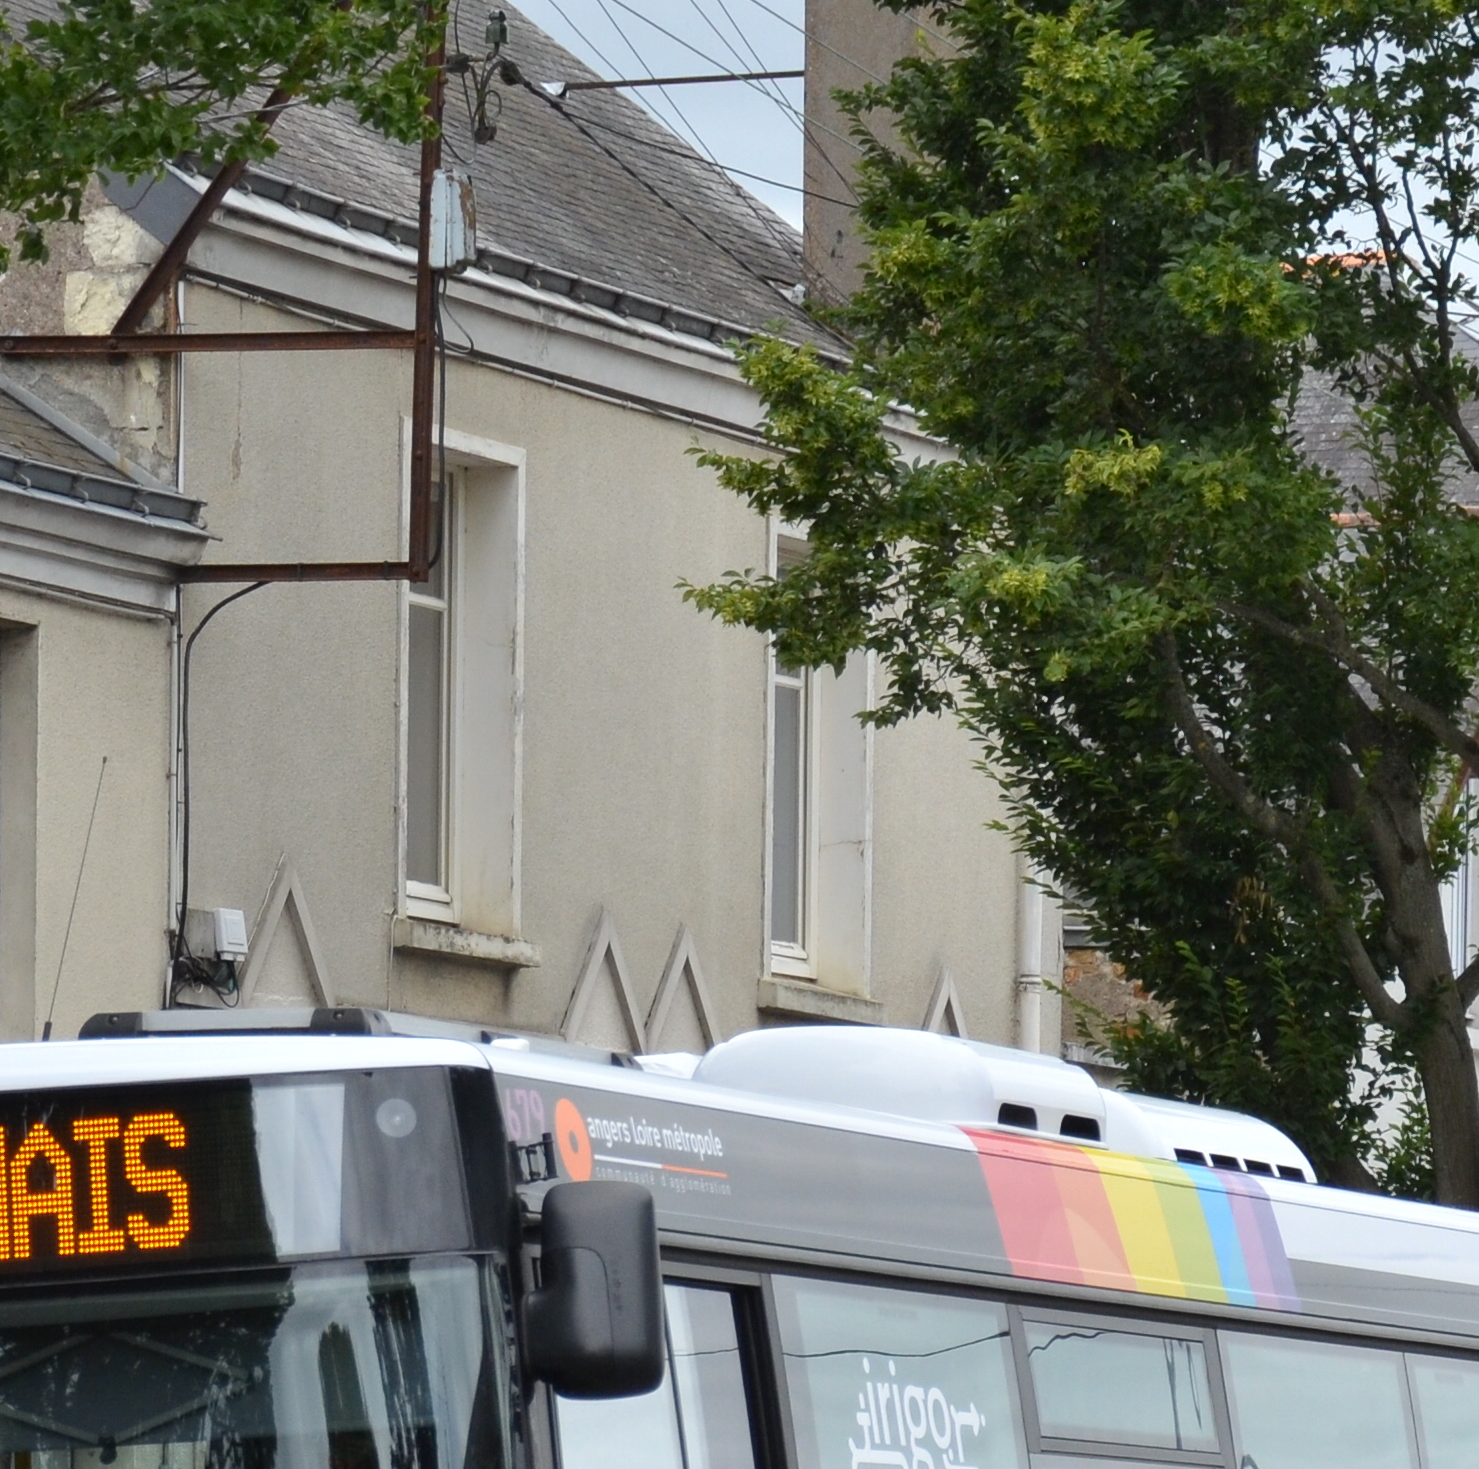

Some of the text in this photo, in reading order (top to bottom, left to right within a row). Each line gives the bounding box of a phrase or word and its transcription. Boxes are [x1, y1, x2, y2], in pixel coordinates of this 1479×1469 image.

[505, 1087, 546, 1141] 679
[587, 1115, 724, 1161] angers loire métropole
